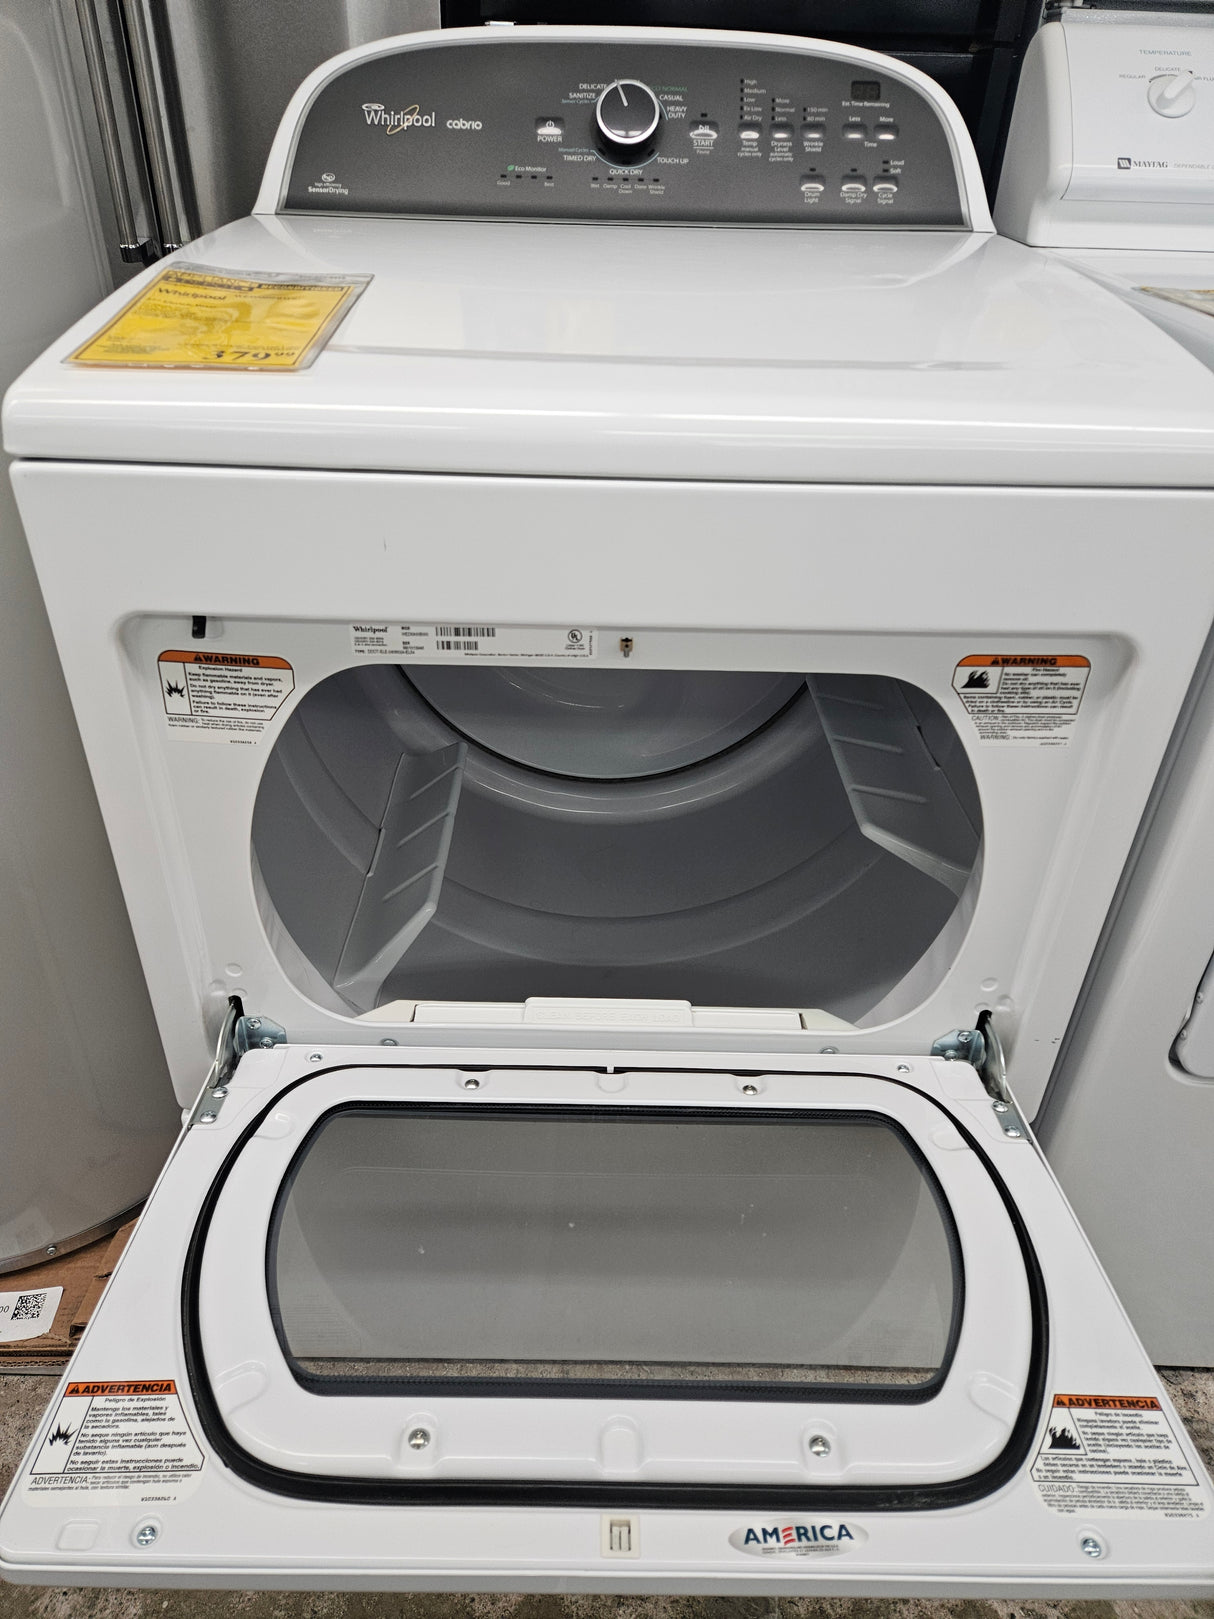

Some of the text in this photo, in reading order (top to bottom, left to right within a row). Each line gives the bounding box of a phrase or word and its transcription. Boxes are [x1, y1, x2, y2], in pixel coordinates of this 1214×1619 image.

[1138, 49, 1192, 57] TEMPERATURE
[364, 109, 436, 131] Whirlpool
[446, 118, 483, 130] cabrio
[1132, 160, 1168, 168] MAYTAG
[308, 186, 349, 195] SensorDrying
[157, 286, 228, 301] Whirlpool
[353, 626, 388, 634] Whirlpool
[203, 655, 260, 666] WARNING
[1001, 657, 1058, 666] WARNING
[81, 1383, 172, 1394] ADVERTENCIA
[1067, 1398, 1160, 1409] ADVERTENCIA
[744, 1524, 855, 1546] AMERICA
